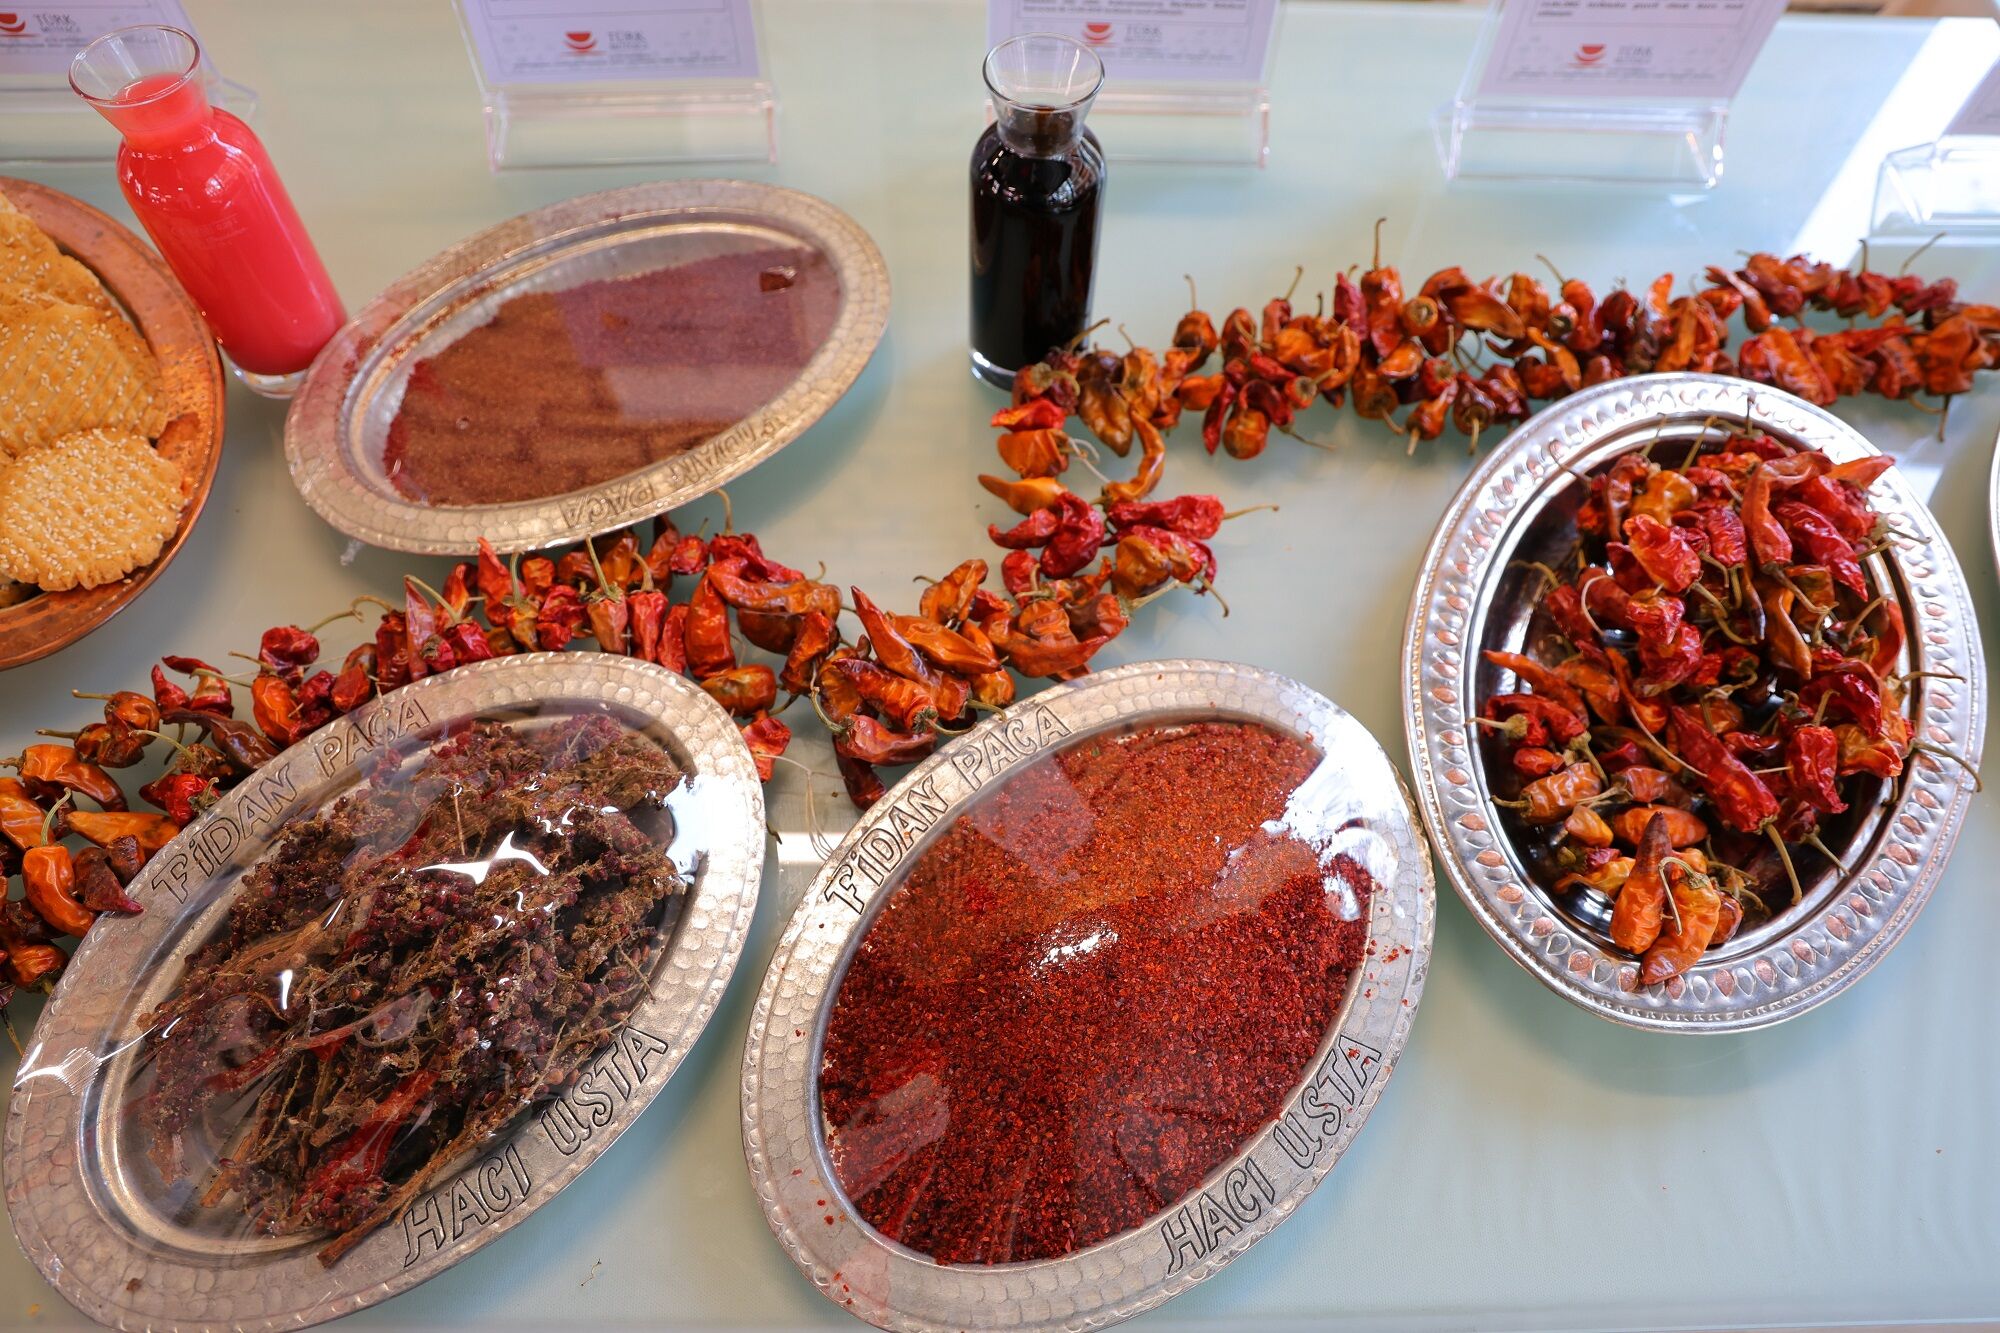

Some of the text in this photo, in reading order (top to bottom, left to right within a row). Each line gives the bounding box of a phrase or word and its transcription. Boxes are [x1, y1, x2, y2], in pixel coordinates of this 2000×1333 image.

[952, 705, 1072, 792] PACA
[403, 1026, 669, 1268] HACI USTA
[1161, 1034, 1382, 1275] HACI USTA
